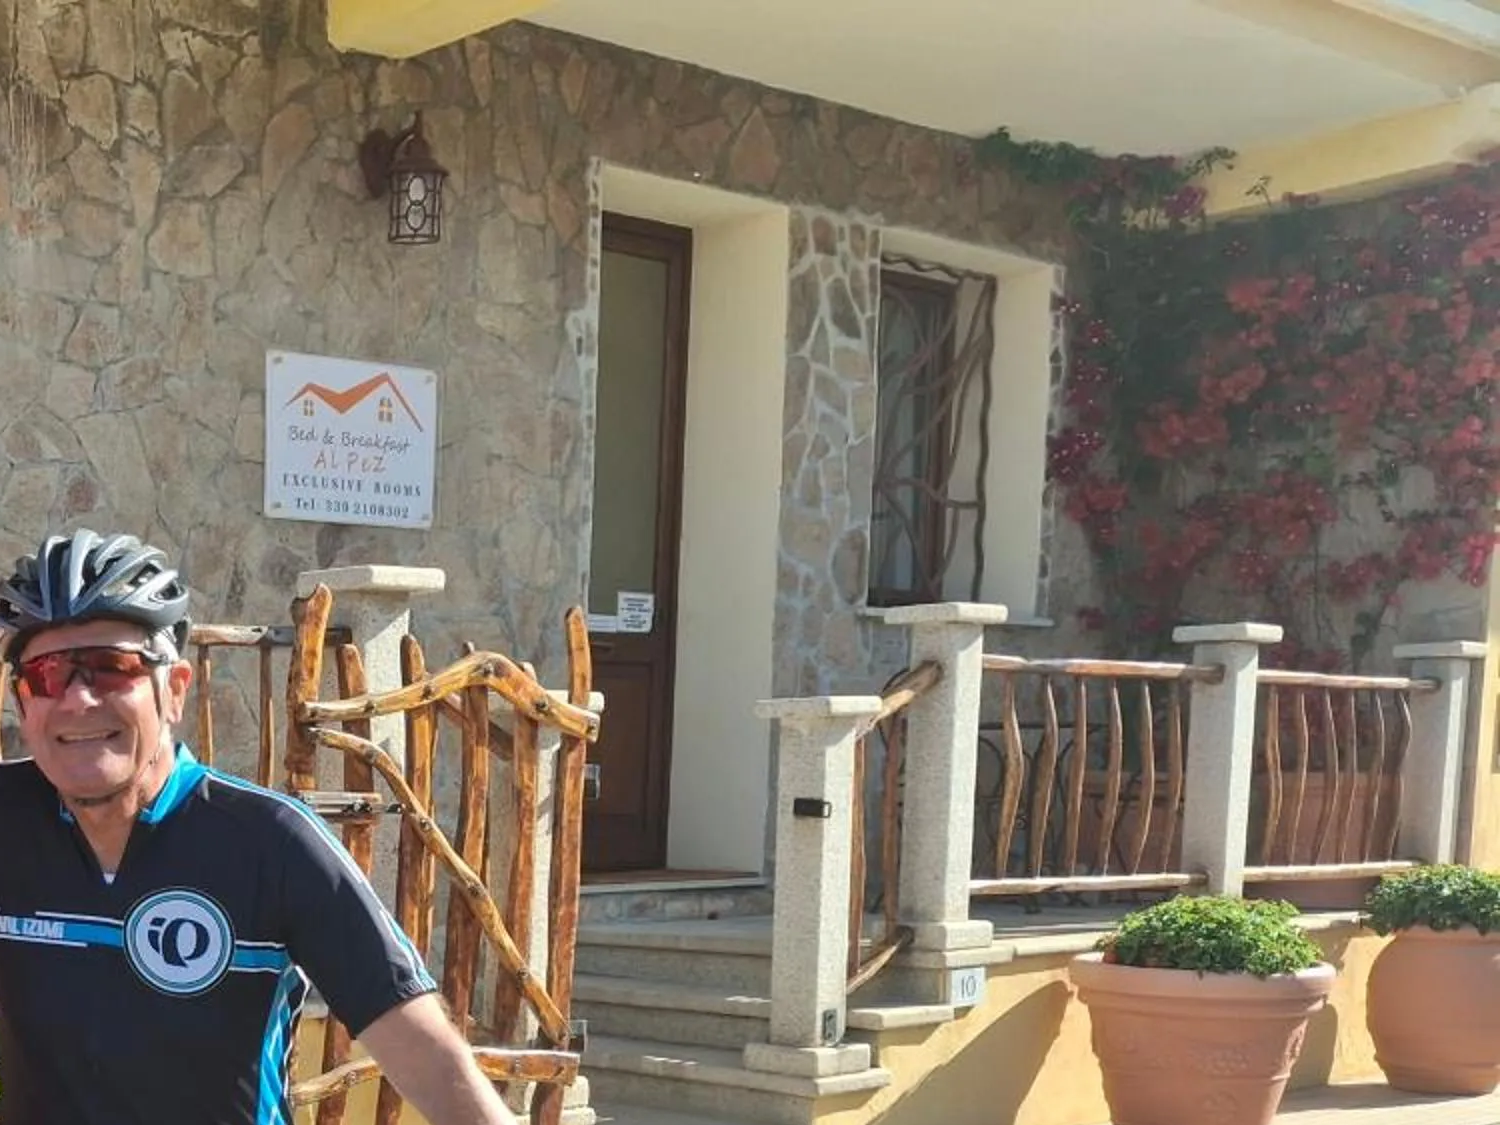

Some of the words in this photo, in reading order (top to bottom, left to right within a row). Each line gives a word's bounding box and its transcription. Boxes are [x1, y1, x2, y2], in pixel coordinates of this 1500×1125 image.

[289, 425, 318, 441] Bed
[323, 427, 335, 445] &
[341, 431, 412, 454] Breakfast
[283, 473, 362, 493] EXCLUSIVE
[373, 481, 421, 497] ROOMS
[961, 975, 977, 999] 10
